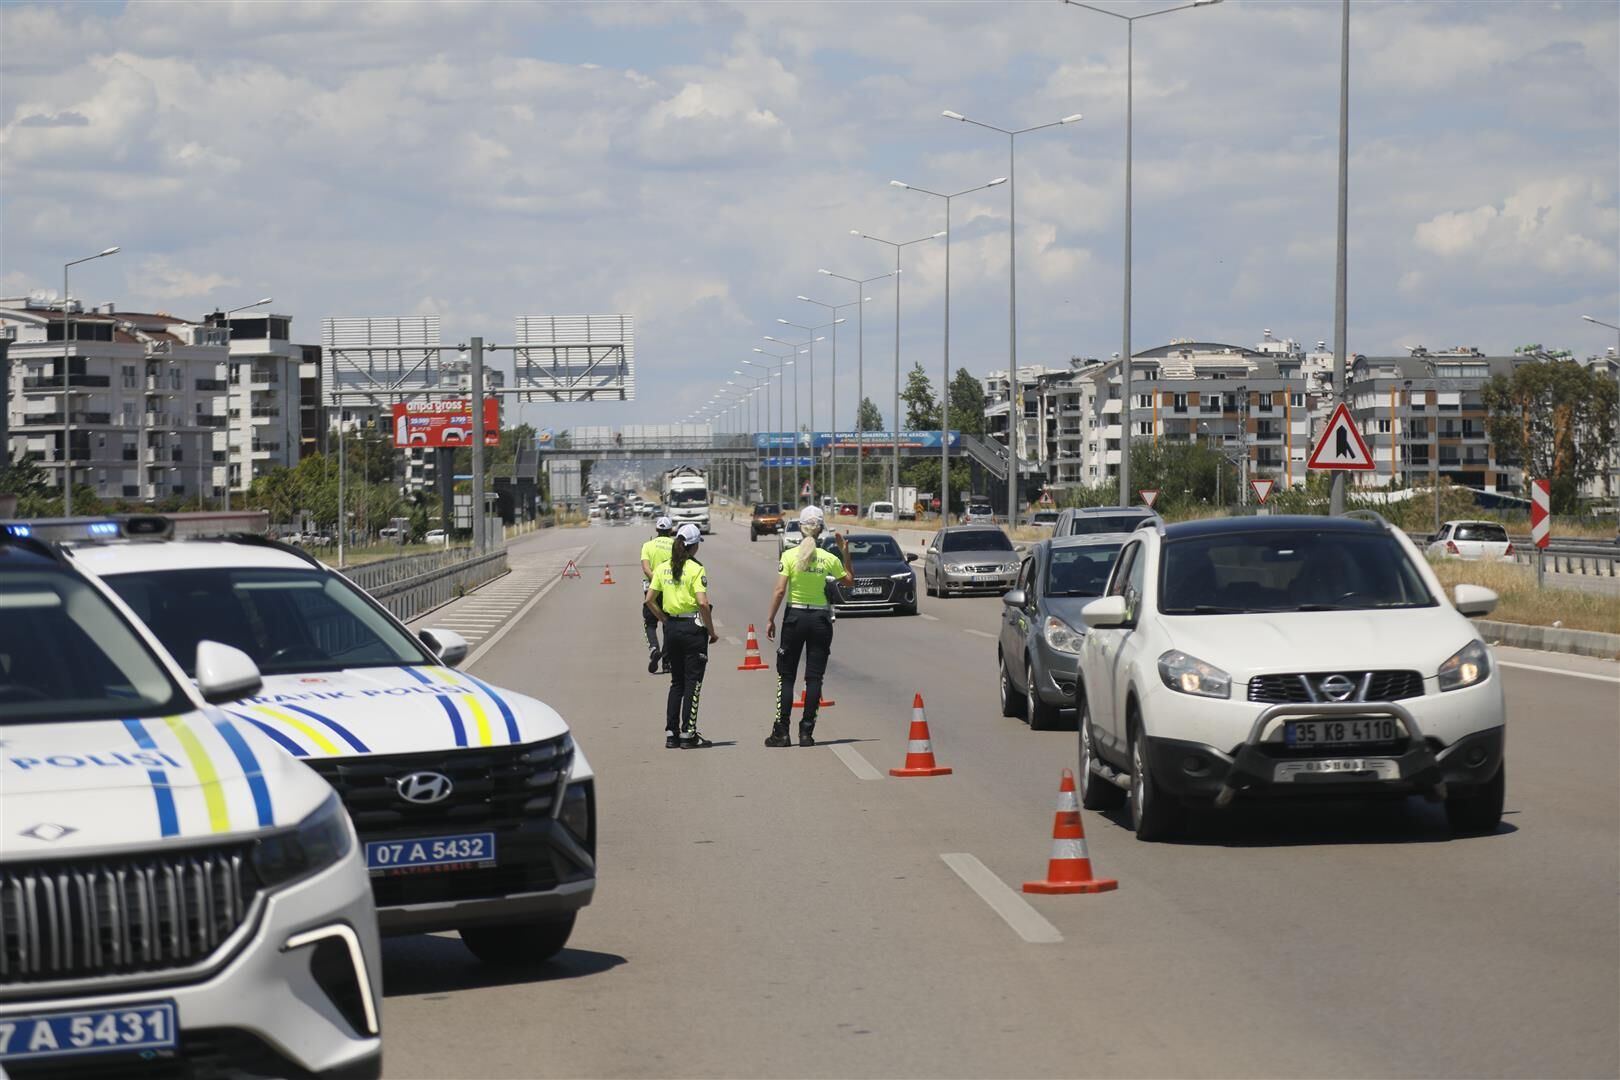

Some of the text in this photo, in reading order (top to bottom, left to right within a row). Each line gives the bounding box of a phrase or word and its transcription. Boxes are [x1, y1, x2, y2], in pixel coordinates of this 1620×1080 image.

[435, 401, 462, 413] gross
[1296, 720, 1393, 742] 35 KB 4110
[1305, 760, 1367, 771] QASHQAI
[376, 838, 484, 864] 07 A 5432
[28, 1019, 59, 1051] A
[69, 1010, 165, 1048] 5431
